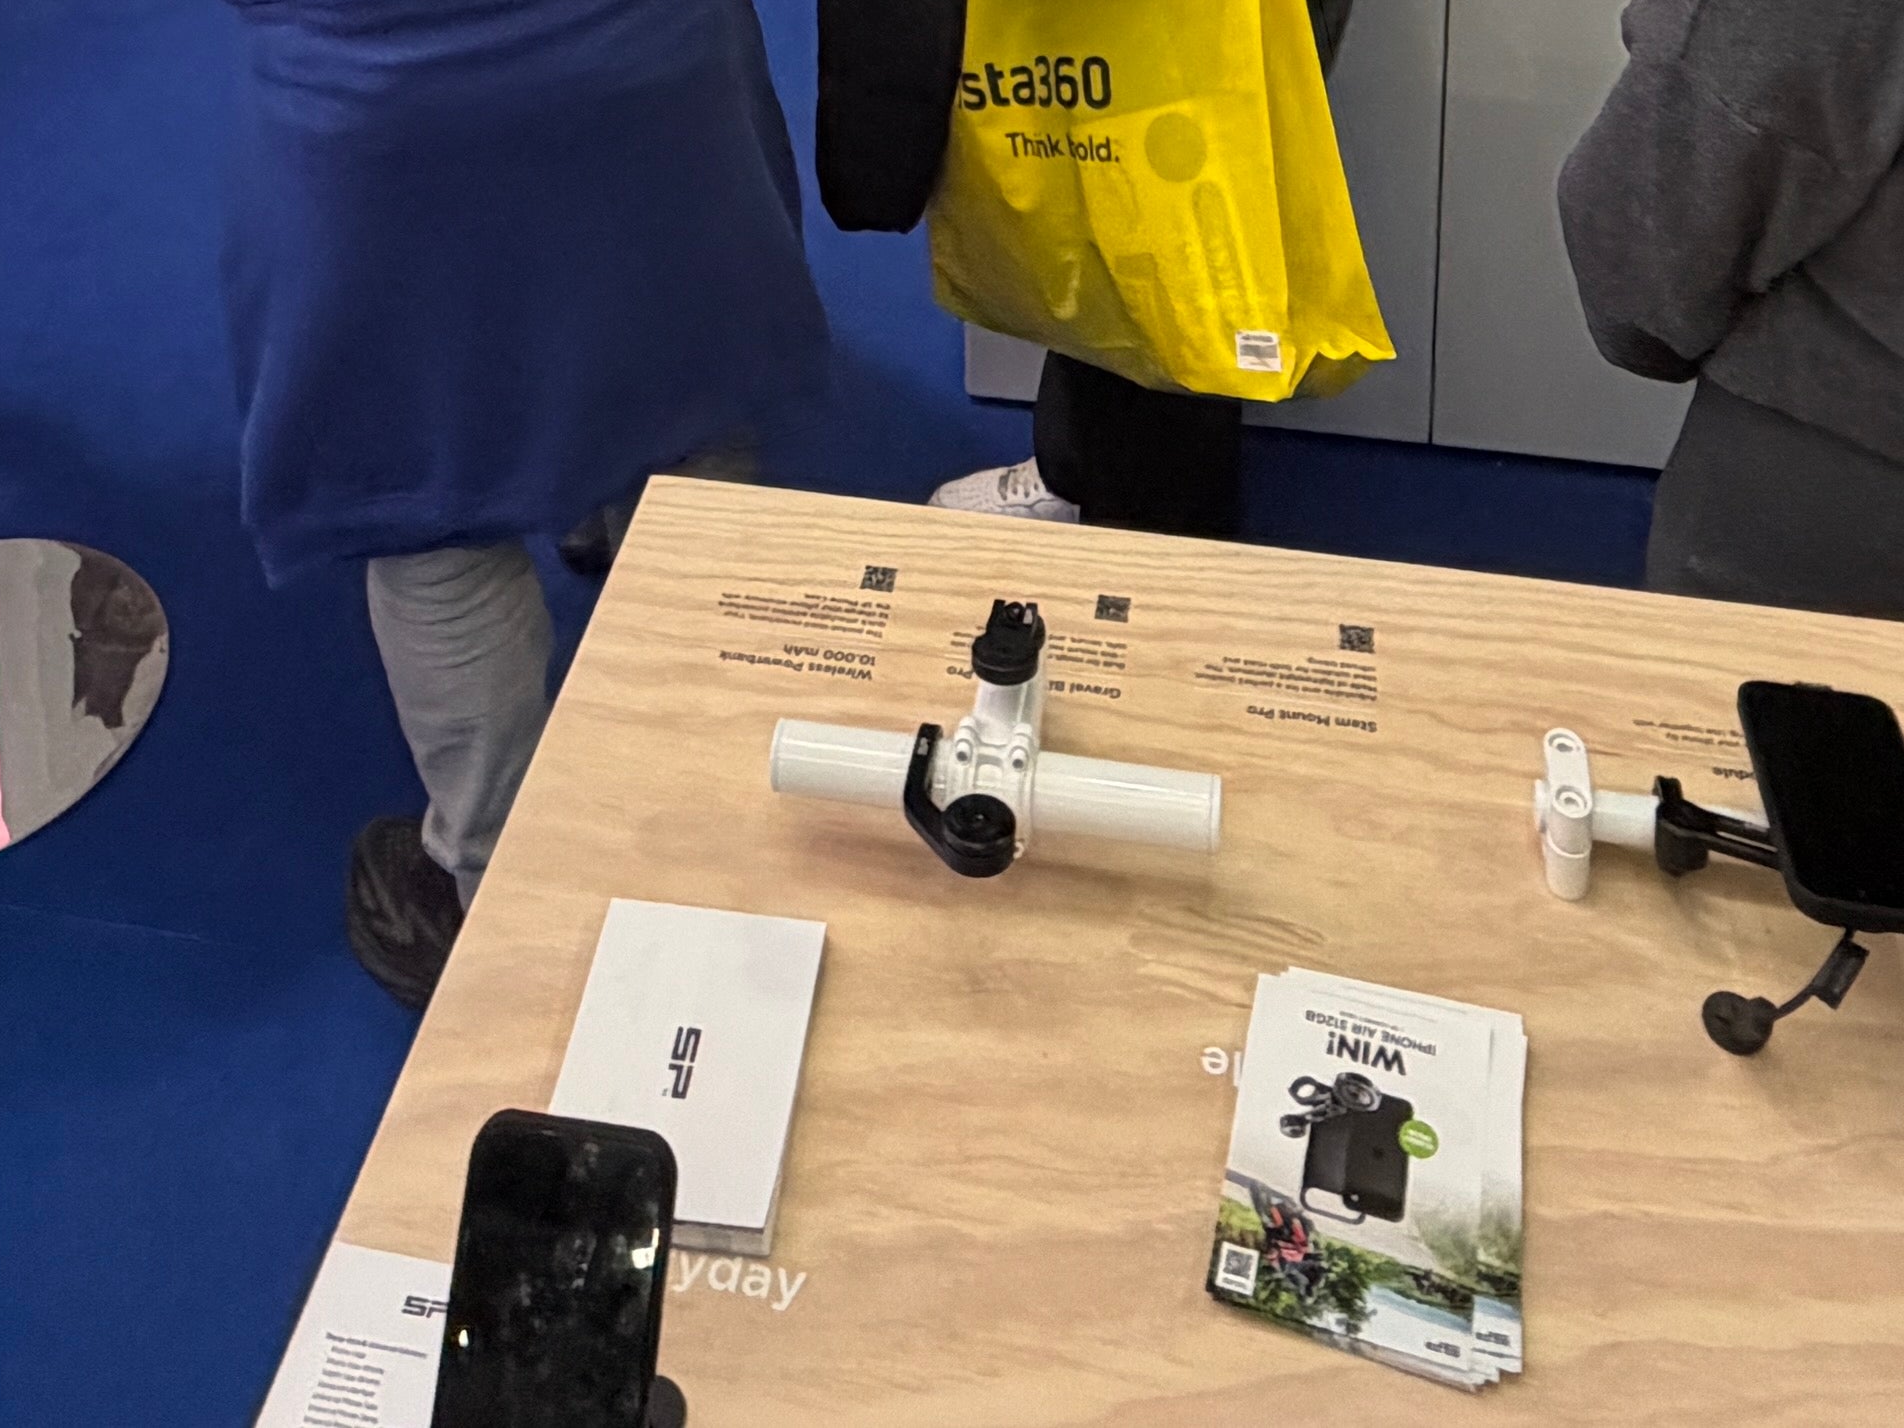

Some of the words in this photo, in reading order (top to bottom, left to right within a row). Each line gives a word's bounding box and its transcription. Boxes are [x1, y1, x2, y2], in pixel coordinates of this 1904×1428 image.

[957, 55, 1112, 112] sta360
[1005, 131, 1061, 159] Think
[783, 642, 820, 657] mAh
[824, 649, 876, 667] 10.000
[718, 649, 804, 673] Powerbank
[808, 661, 873, 681] Wireless
[947, 664, 977, 681] Pro
[1045, 680, 1066, 692] Bi
[1070, 680, 1122, 700] Gravel
[1247, 704, 1276, 719] Pro
[1280, 709, 1330, 727] Mount
[1336, 715, 1377, 733] Stem
[1712, 767, 1754, 779] dule
[1351, 1022, 1378, 1037] AIR
[668, 1026, 702, 1100] SP
[1326, 1031, 1407, 1077] WIN!
[670, 1250, 807, 1312] yday
